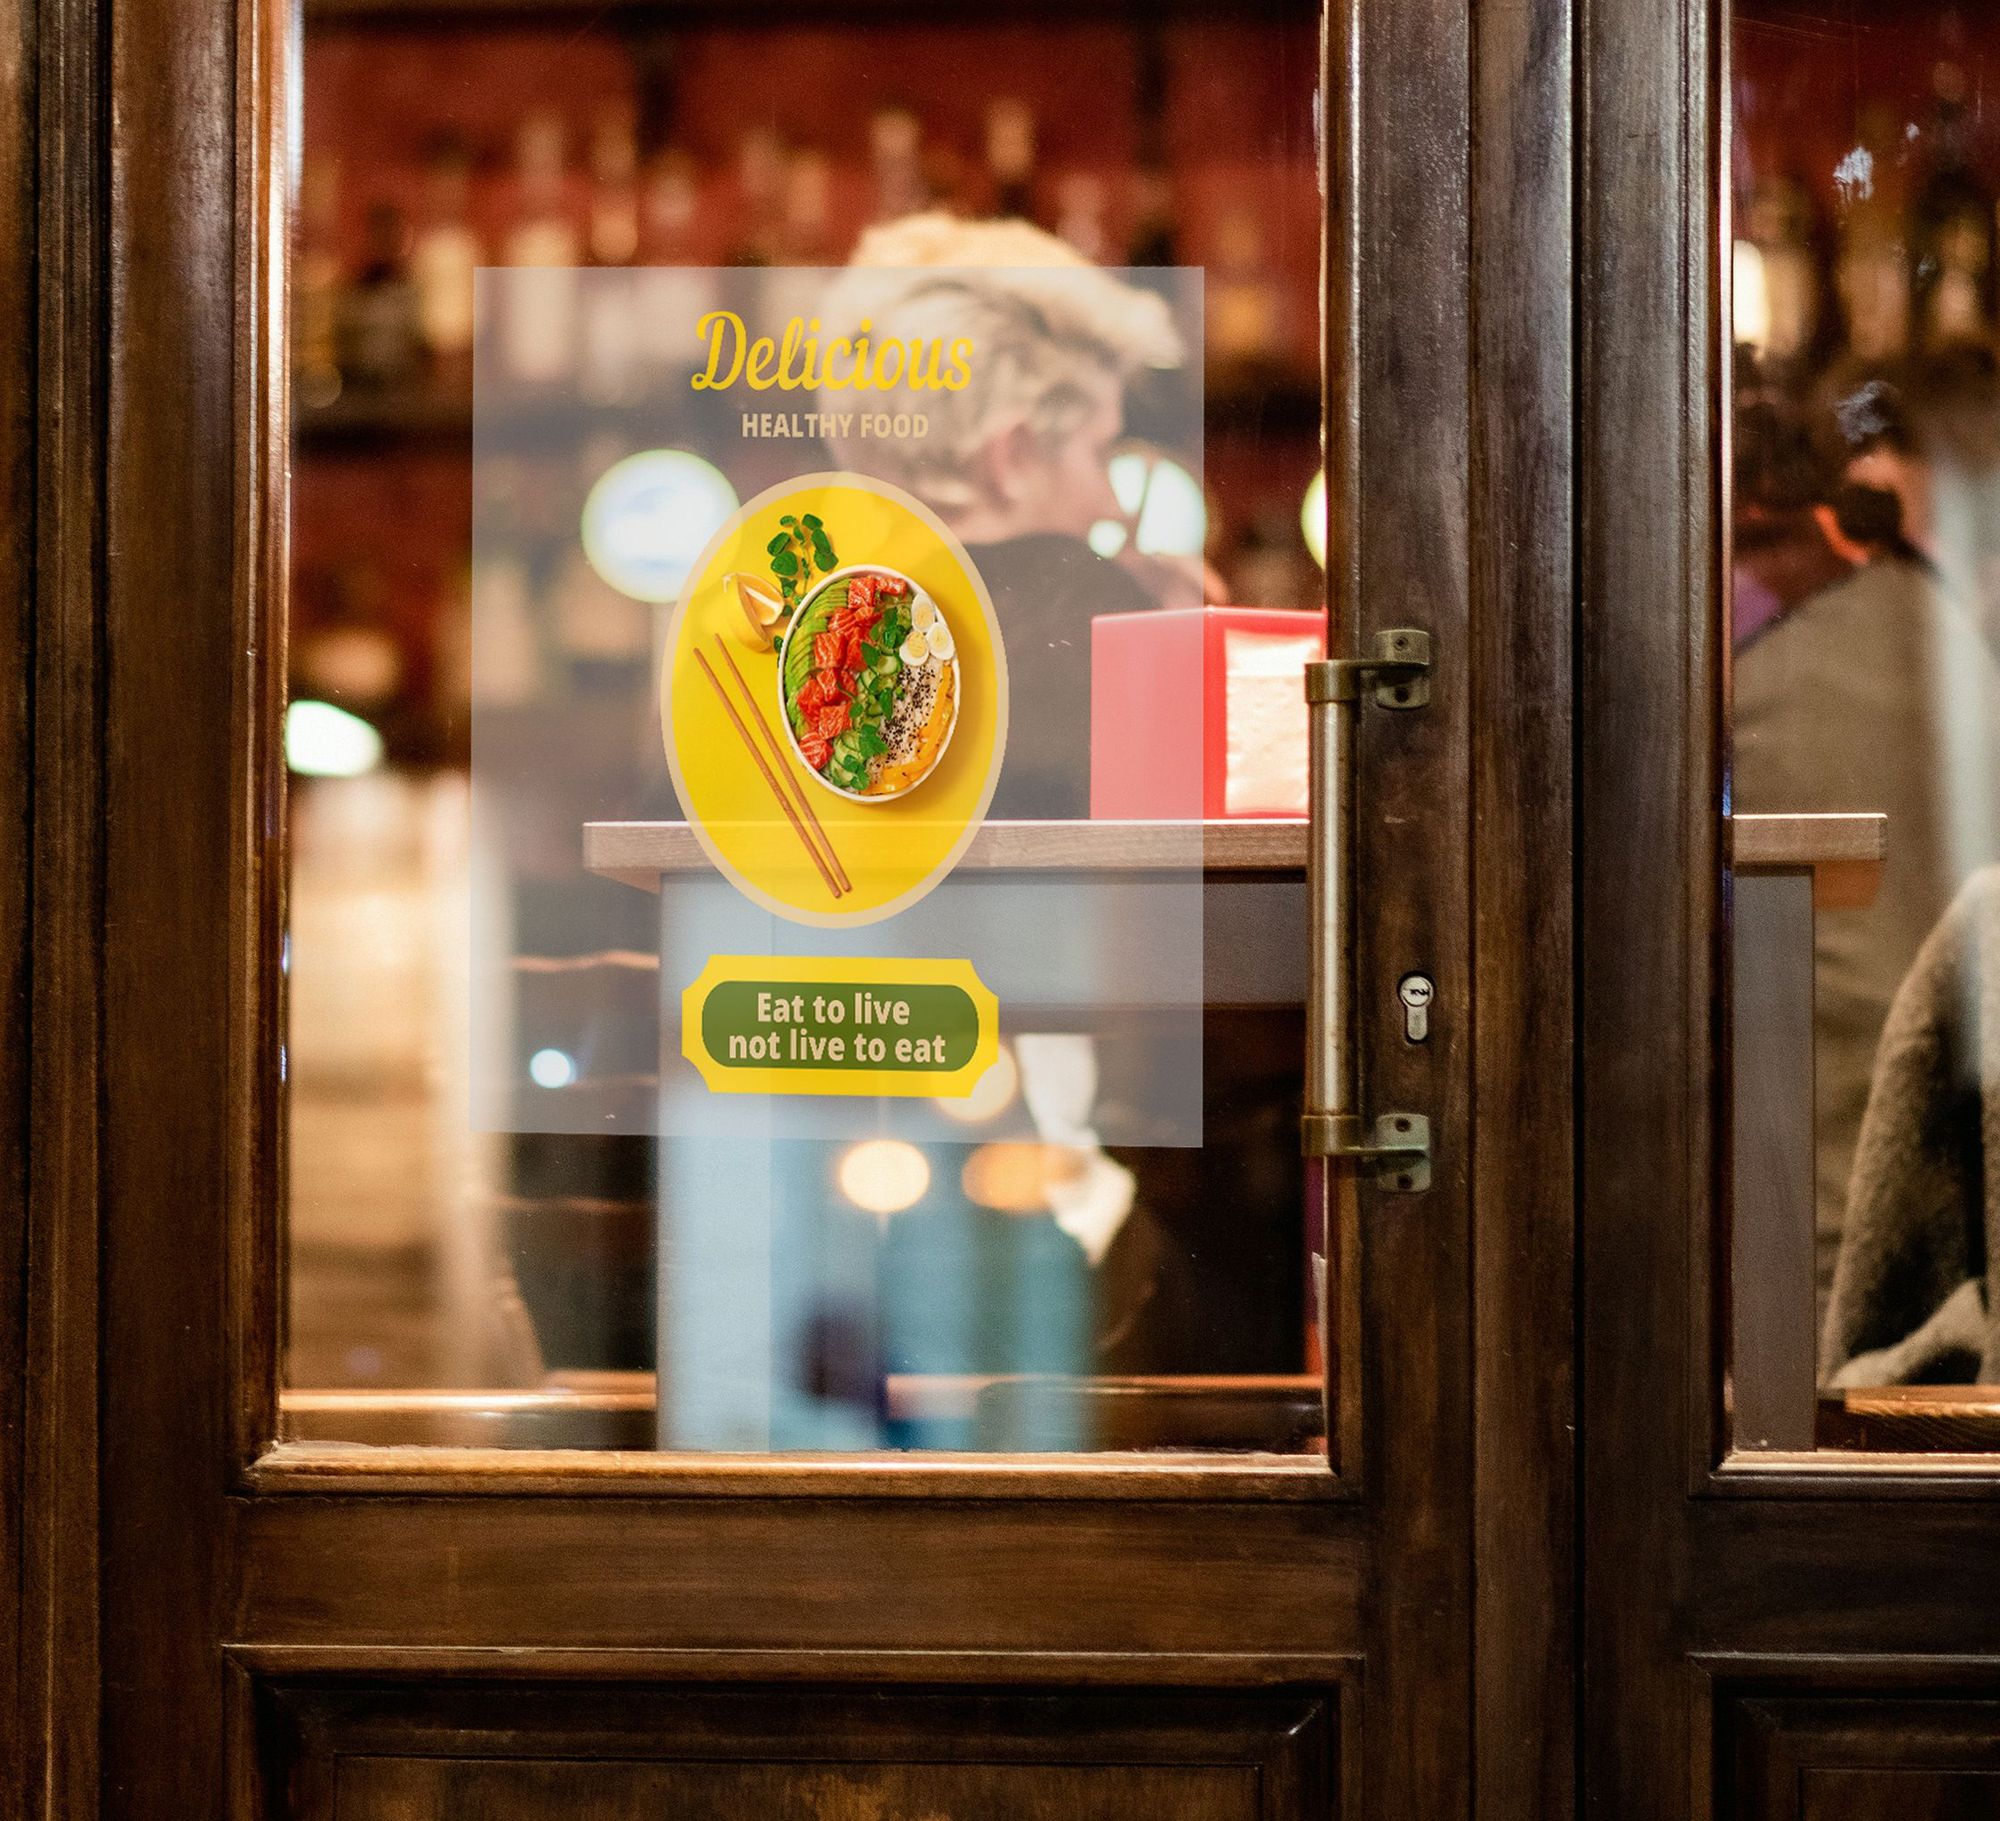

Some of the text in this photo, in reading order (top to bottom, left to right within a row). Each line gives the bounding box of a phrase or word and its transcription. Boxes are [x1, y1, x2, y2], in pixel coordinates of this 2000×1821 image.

[691, 311, 974, 391] Delicious
[742, 413, 929, 438] HEALTHY FOOD
[757, 992, 910, 1025] Eat to live
[729, 1028, 946, 1063] not live to eat
